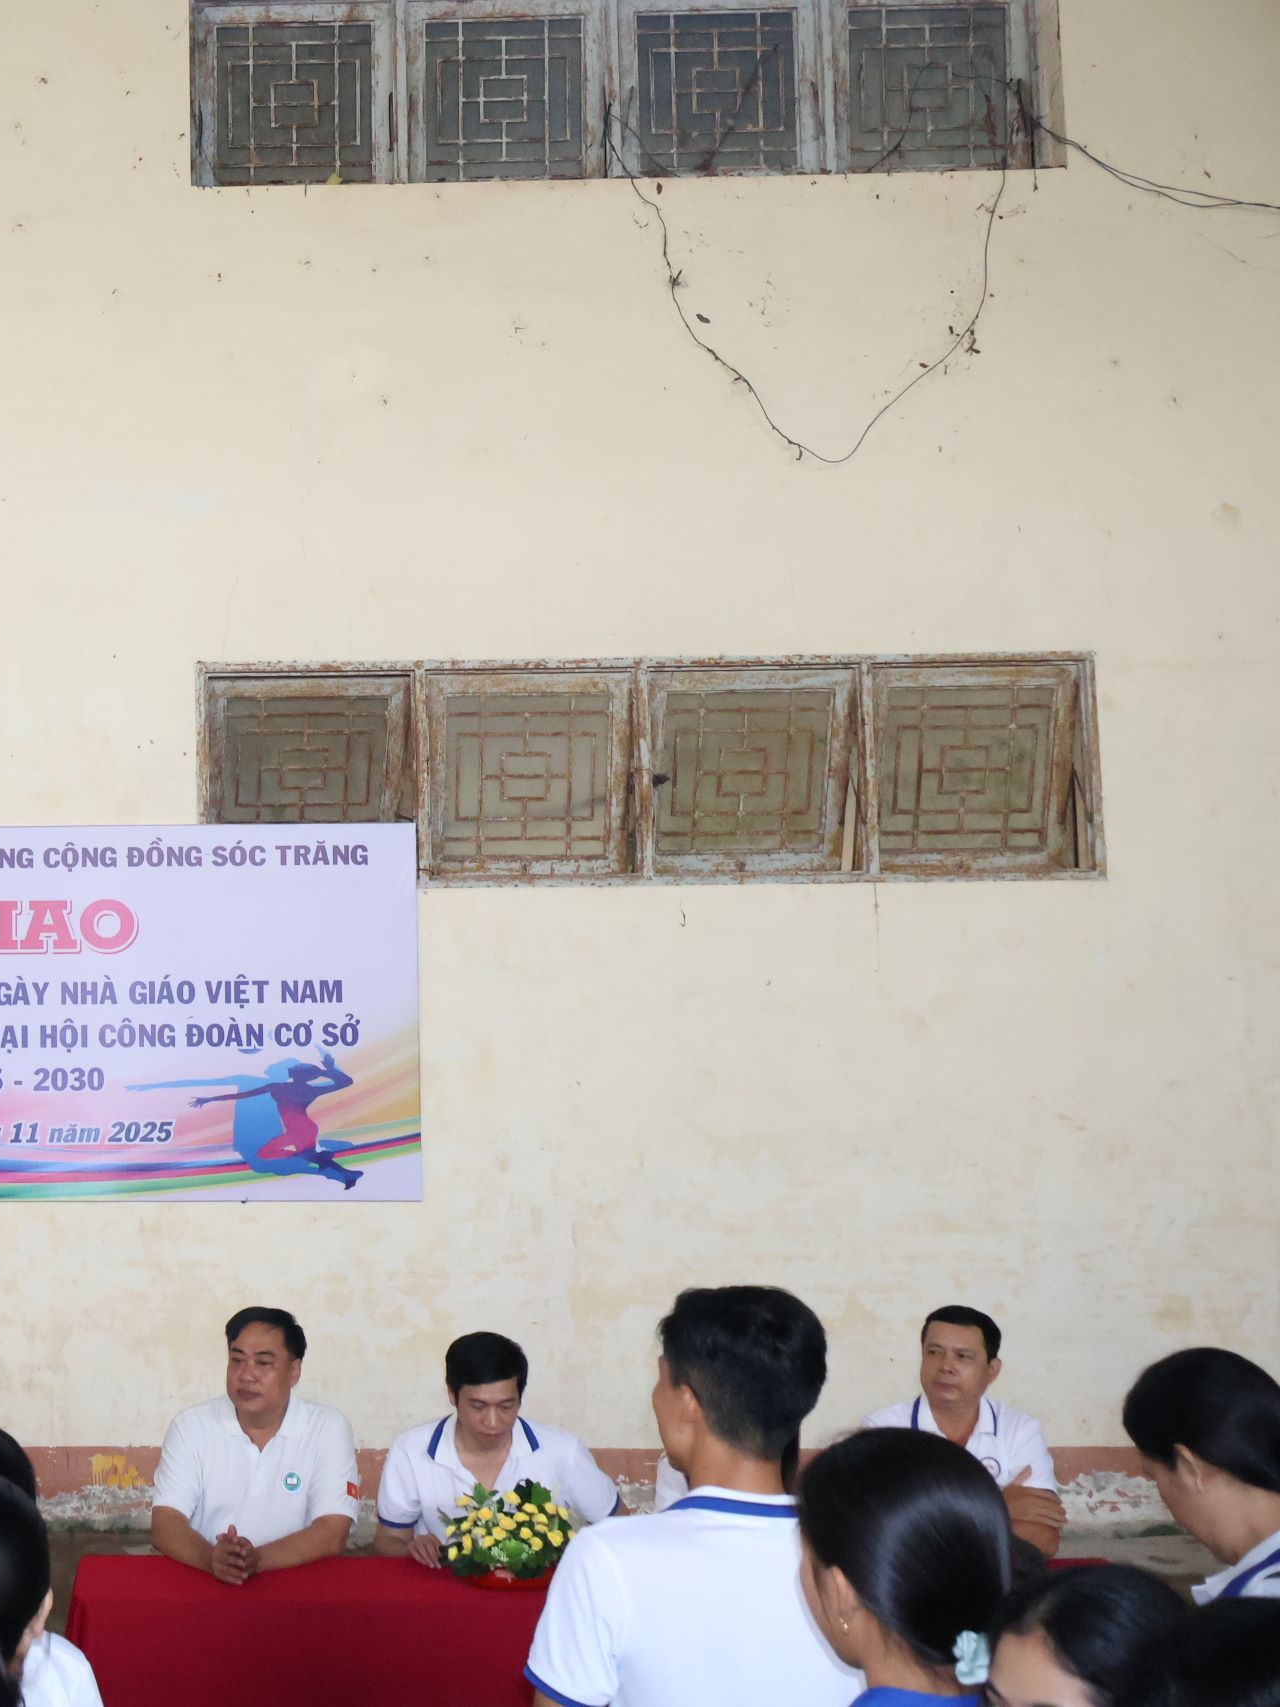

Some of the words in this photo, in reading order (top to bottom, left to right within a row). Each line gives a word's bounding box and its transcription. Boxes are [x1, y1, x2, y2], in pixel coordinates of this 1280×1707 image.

[43, 841, 117, 873] CỘNG
[126, 837, 203, 868] ĐỒNG
[211, 839, 266, 866] SÓC
[275, 841, 369, 866] TRĂNG
[61, 976, 118, 1005] NHÀ
[129, 974, 195, 1004] GIÁO
[206, 974, 270, 1009] VIỆT
[281, 980, 343, 1003] NAM
[40, 1018, 88, 1053] HỘI
[99, 1018, 176, 1048] CÔNG
[185, 1018, 264, 1048] ĐOÀN
[275, 1019, 314, 1046] CƠ
[322, 1014, 361, 1047] SỞ
[33, 1067, 105, 1092] 2030
[10, 1122, 39, 1144] 11
[49, 1121, 101, 1144] năm
[108, 1121, 174, 1143] 2025
